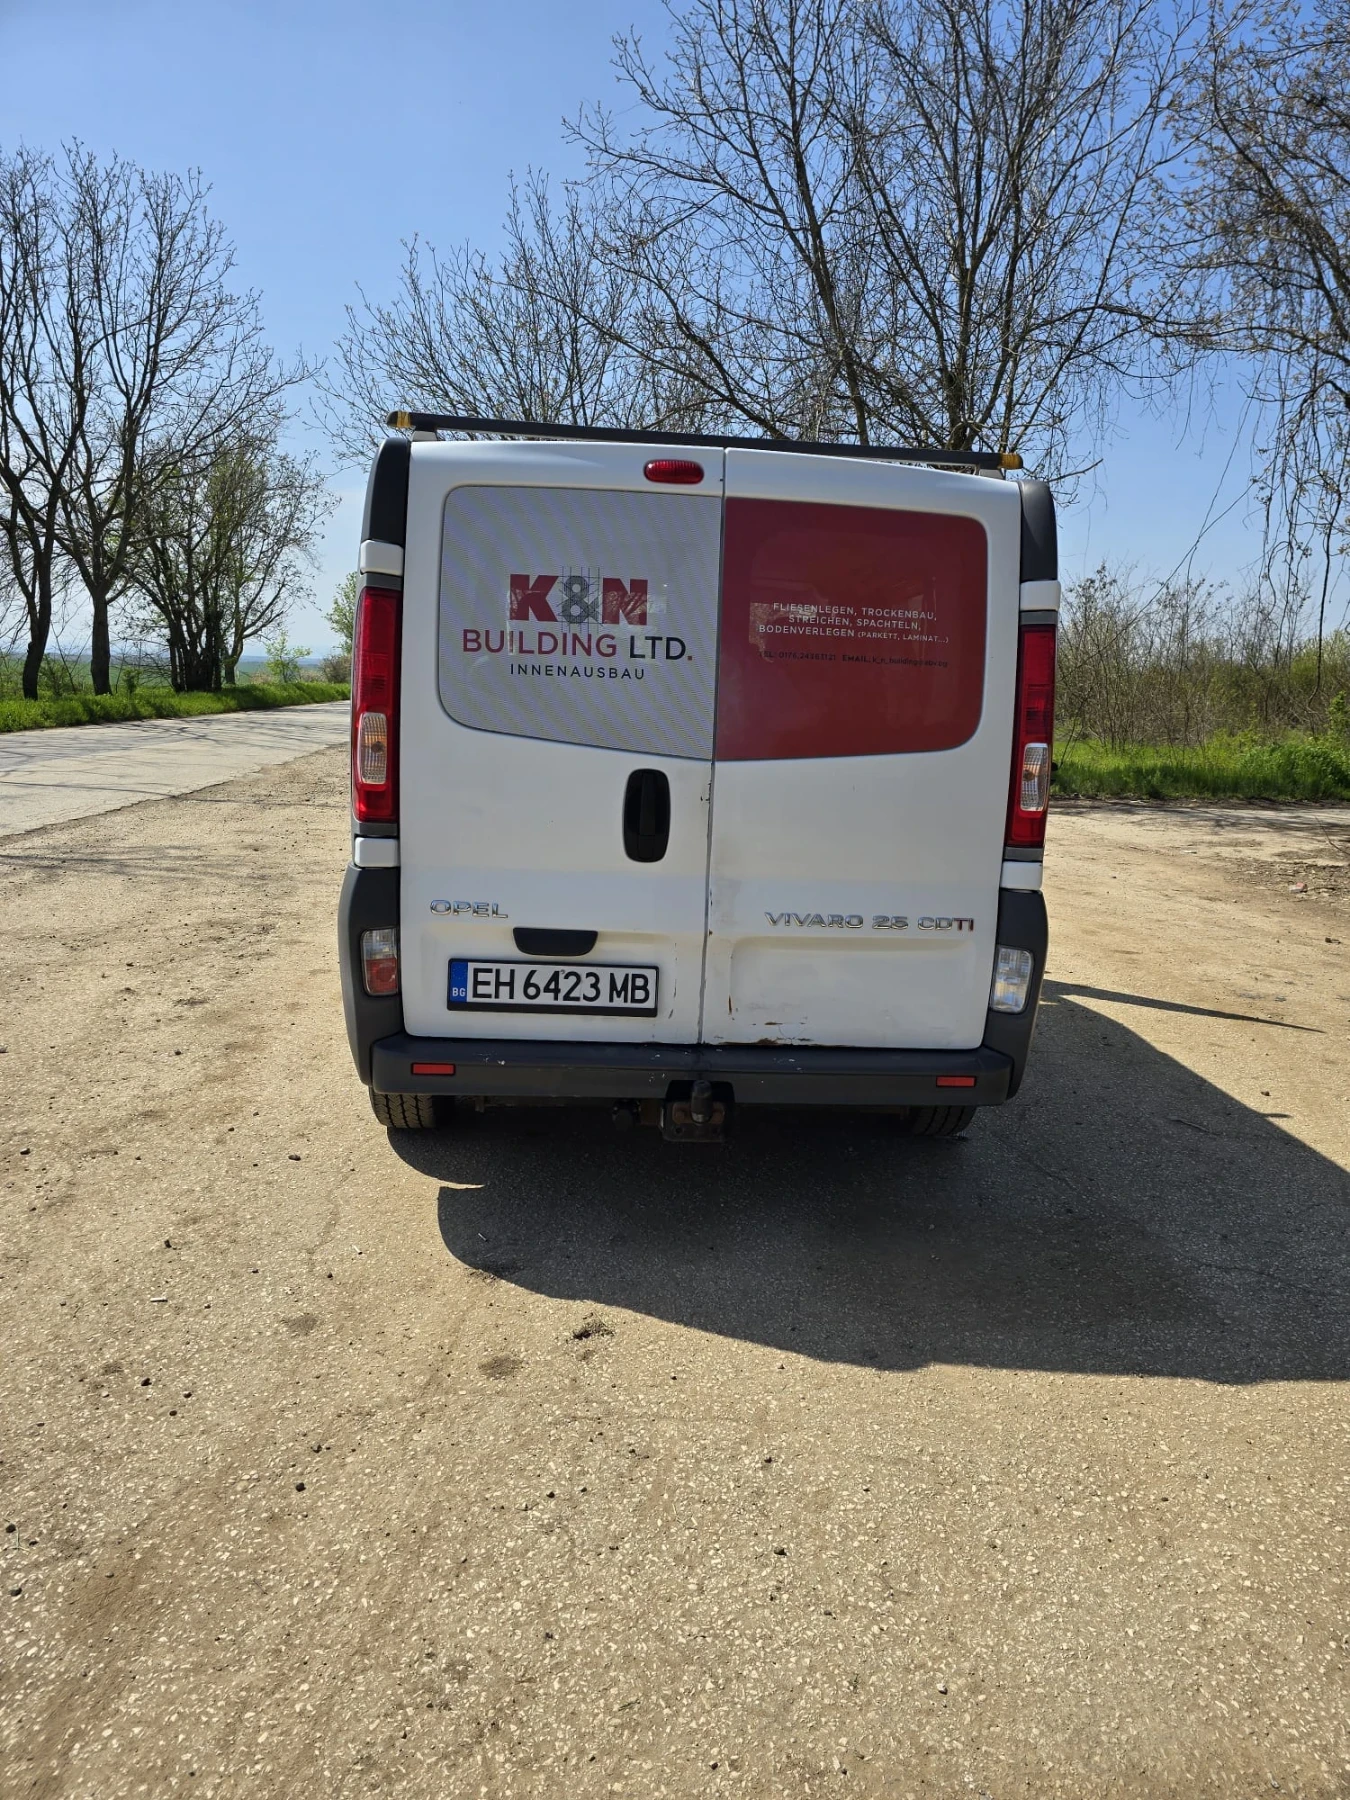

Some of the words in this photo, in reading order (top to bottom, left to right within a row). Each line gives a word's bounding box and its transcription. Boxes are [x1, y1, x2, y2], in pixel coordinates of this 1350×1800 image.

[509, 574, 648, 626] K&N
[773, 602, 857, 616] FLIESENLEGEN,
[861, 607, 937, 621] TROCKENBAU,
[788, 614, 853, 627] STREICHEN,
[856, 619, 921, 631] SPACHTELN,
[759, 625, 855, 637] BODENVERLEGEN
[857, 631, 900, 641] (PARKETT,
[463, 629, 617, 658] BUILDING
[629, 635, 693, 661] LTD.
[510, 663, 645, 680] INNENAUSBAU
[430, 899, 509, 918] OPEL
[764, 911, 864, 929] VIVARO
[917, 916, 975, 932] CDTI
[452, 987, 466, 997] BG
[472, 968, 515, 1000] EH
[523, 969, 601, 1003] 6423
[608, 972, 650, 1004] MB
